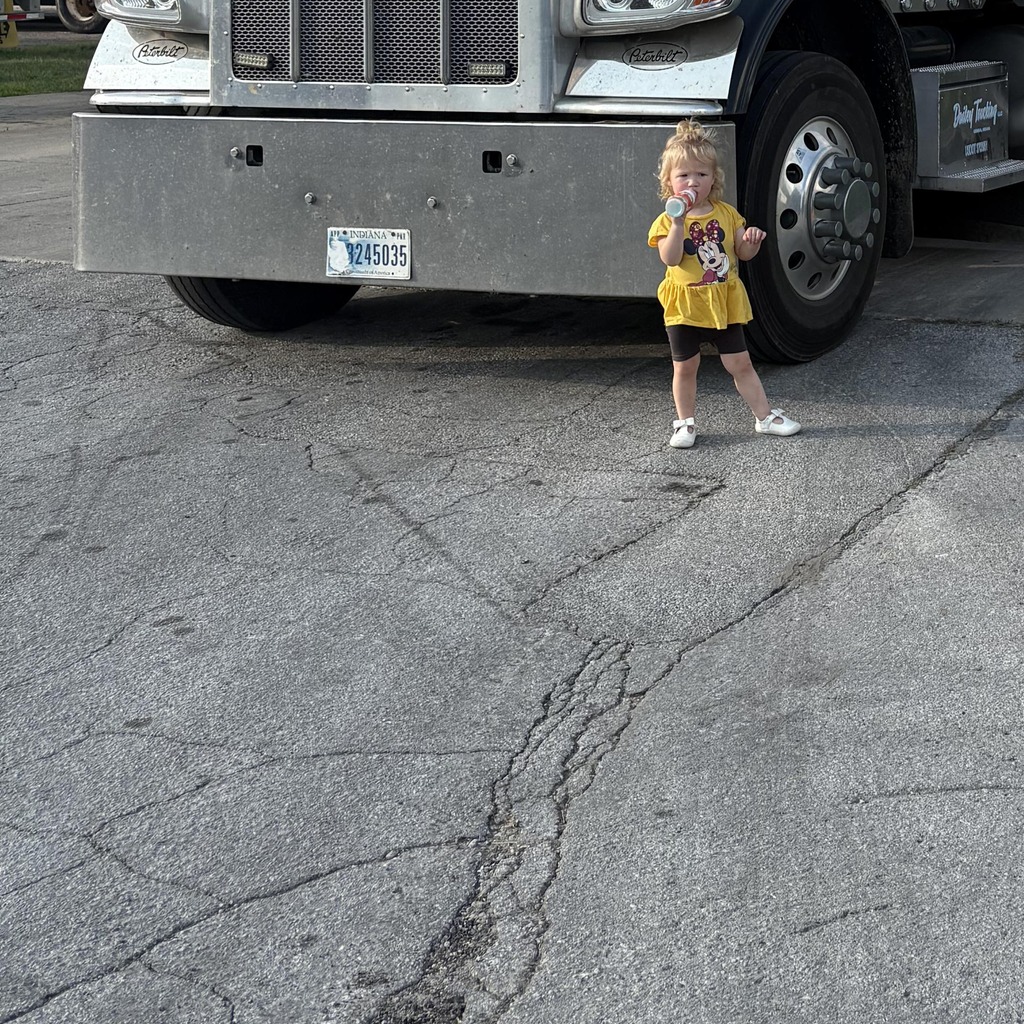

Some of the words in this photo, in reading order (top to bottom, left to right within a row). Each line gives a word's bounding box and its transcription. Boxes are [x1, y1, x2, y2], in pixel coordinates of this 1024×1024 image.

[137, 44, 185, 59] Peterbilt
[628, 47, 683, 63] Peterbilt
[974, 97, 998, 126] Trucking
[349, 230, 387, 240] INDIANA
